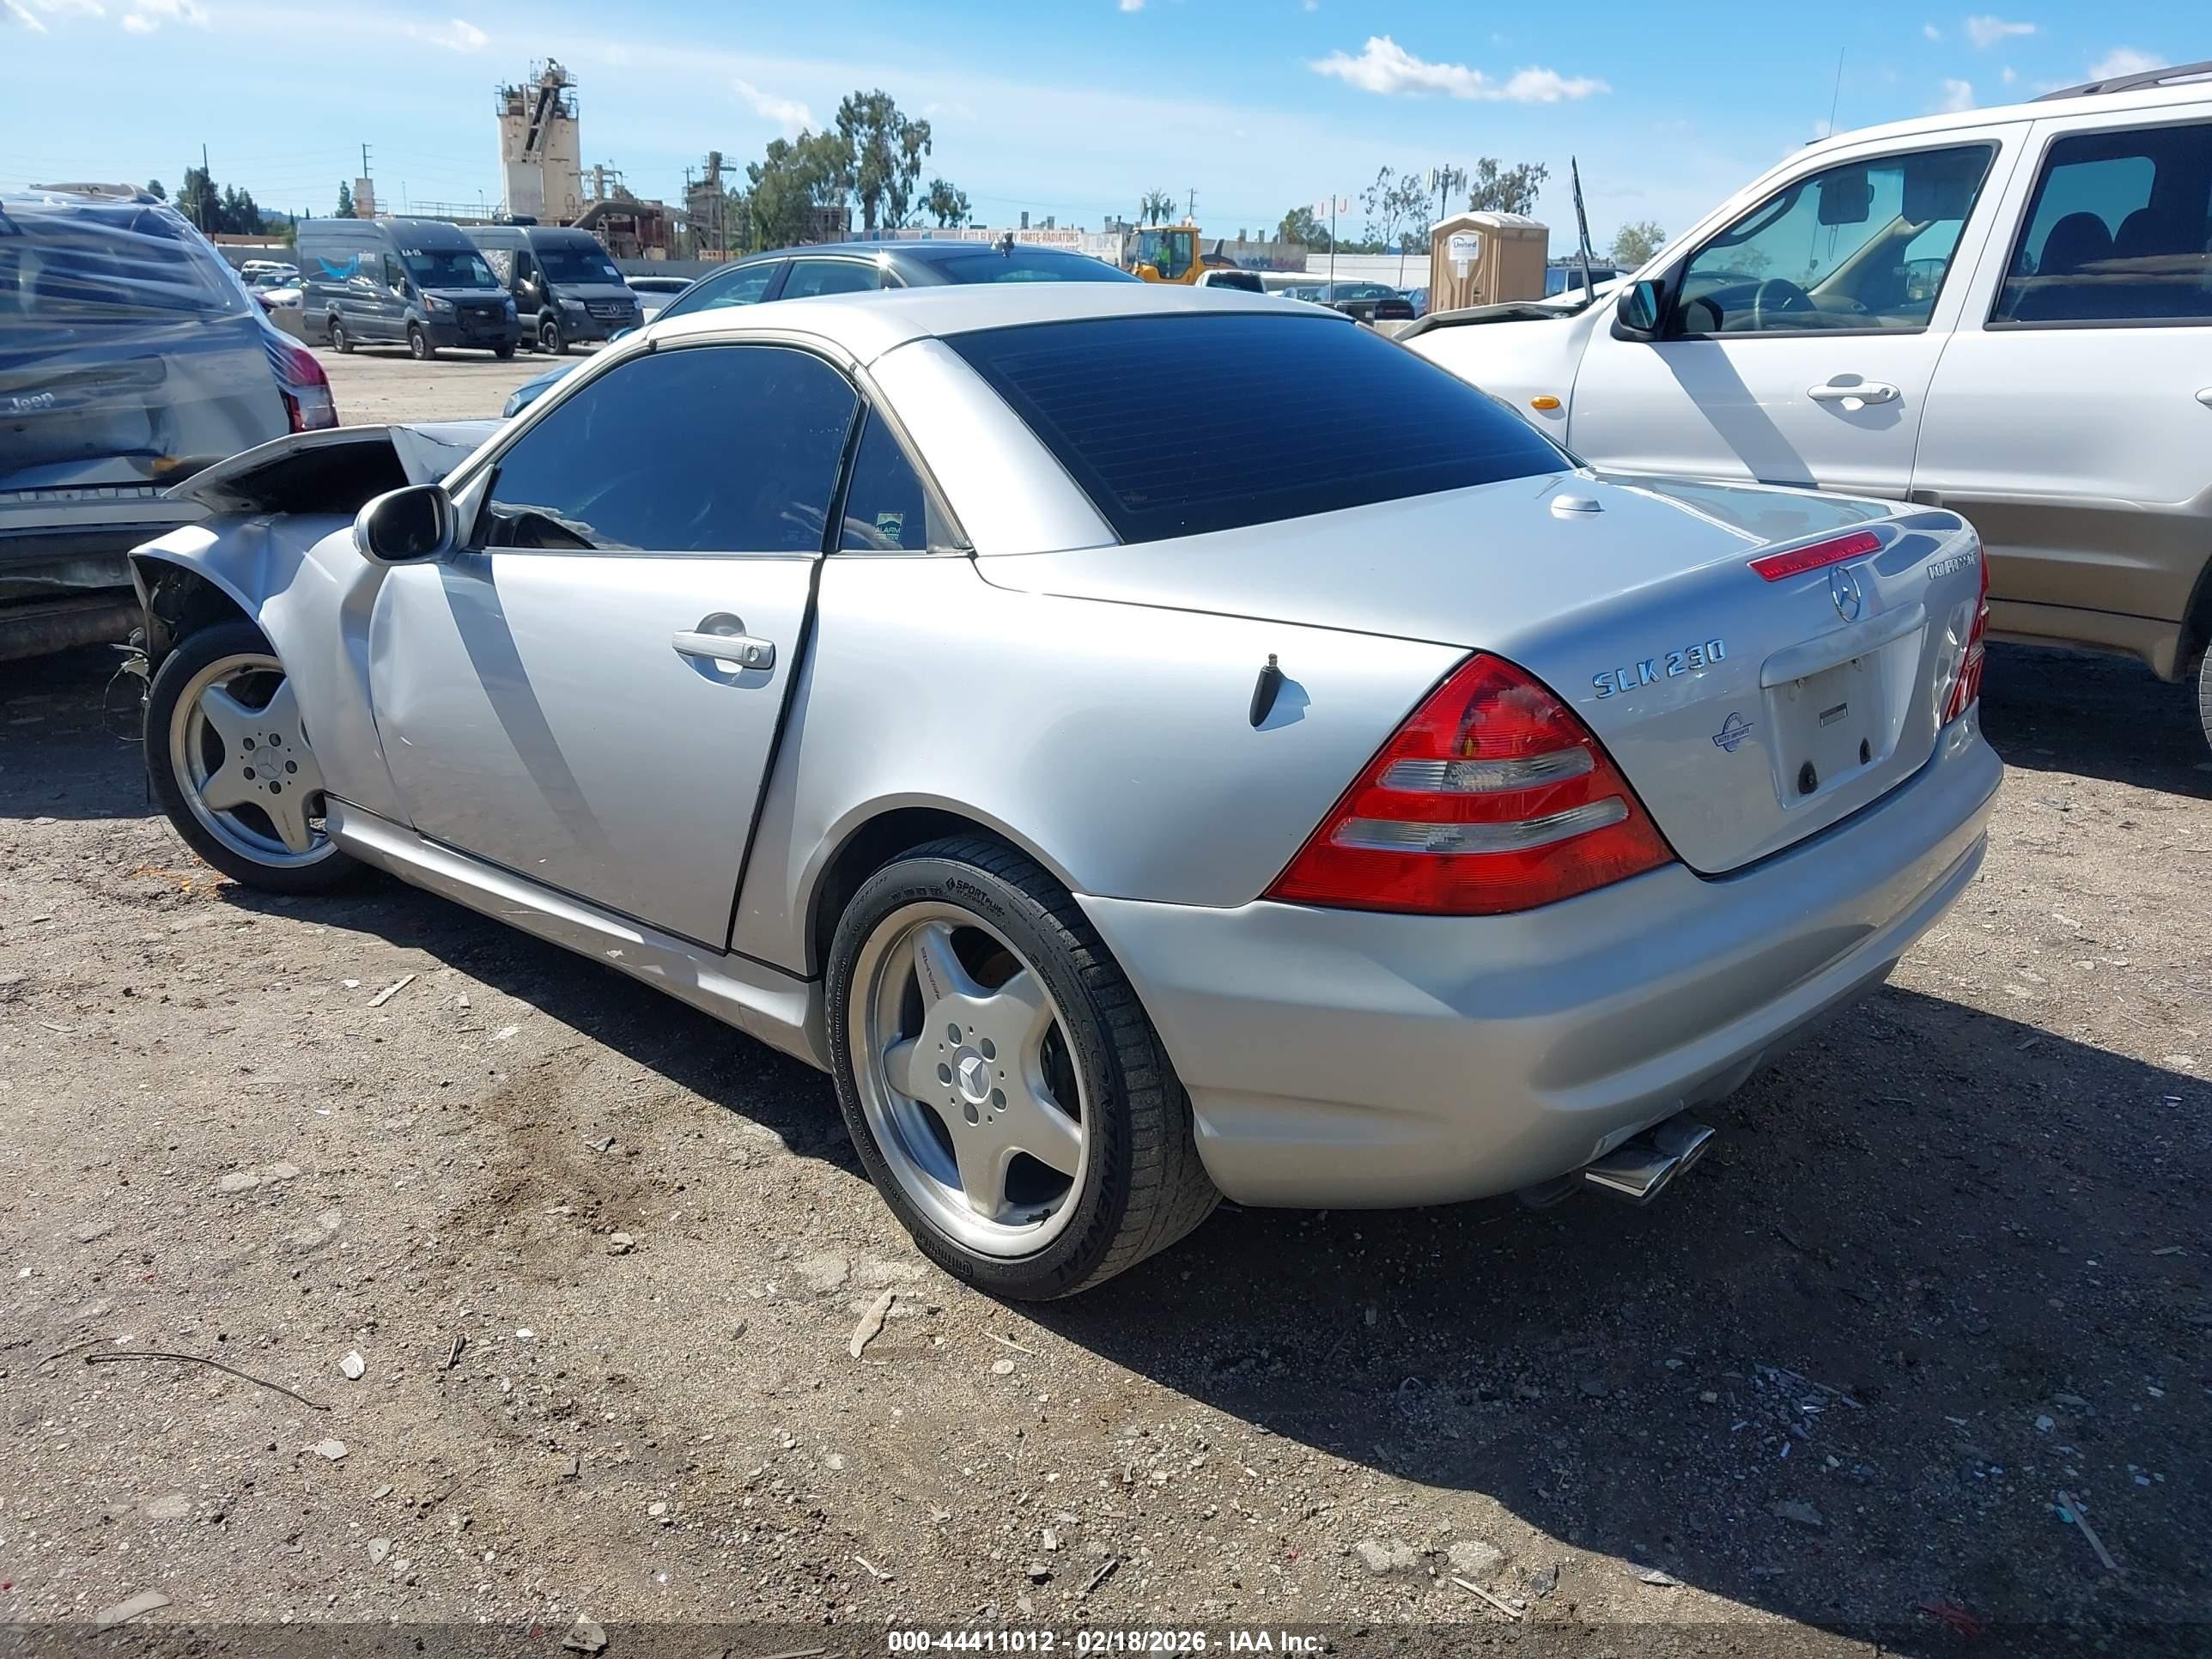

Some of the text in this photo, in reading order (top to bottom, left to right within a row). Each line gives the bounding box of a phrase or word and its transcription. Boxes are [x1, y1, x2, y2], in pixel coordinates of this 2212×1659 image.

[1453, 240, 1477, 249] United
[8, 392, 55, 413] Jeep
[1593, 639, 1727, 700] SLK 230
